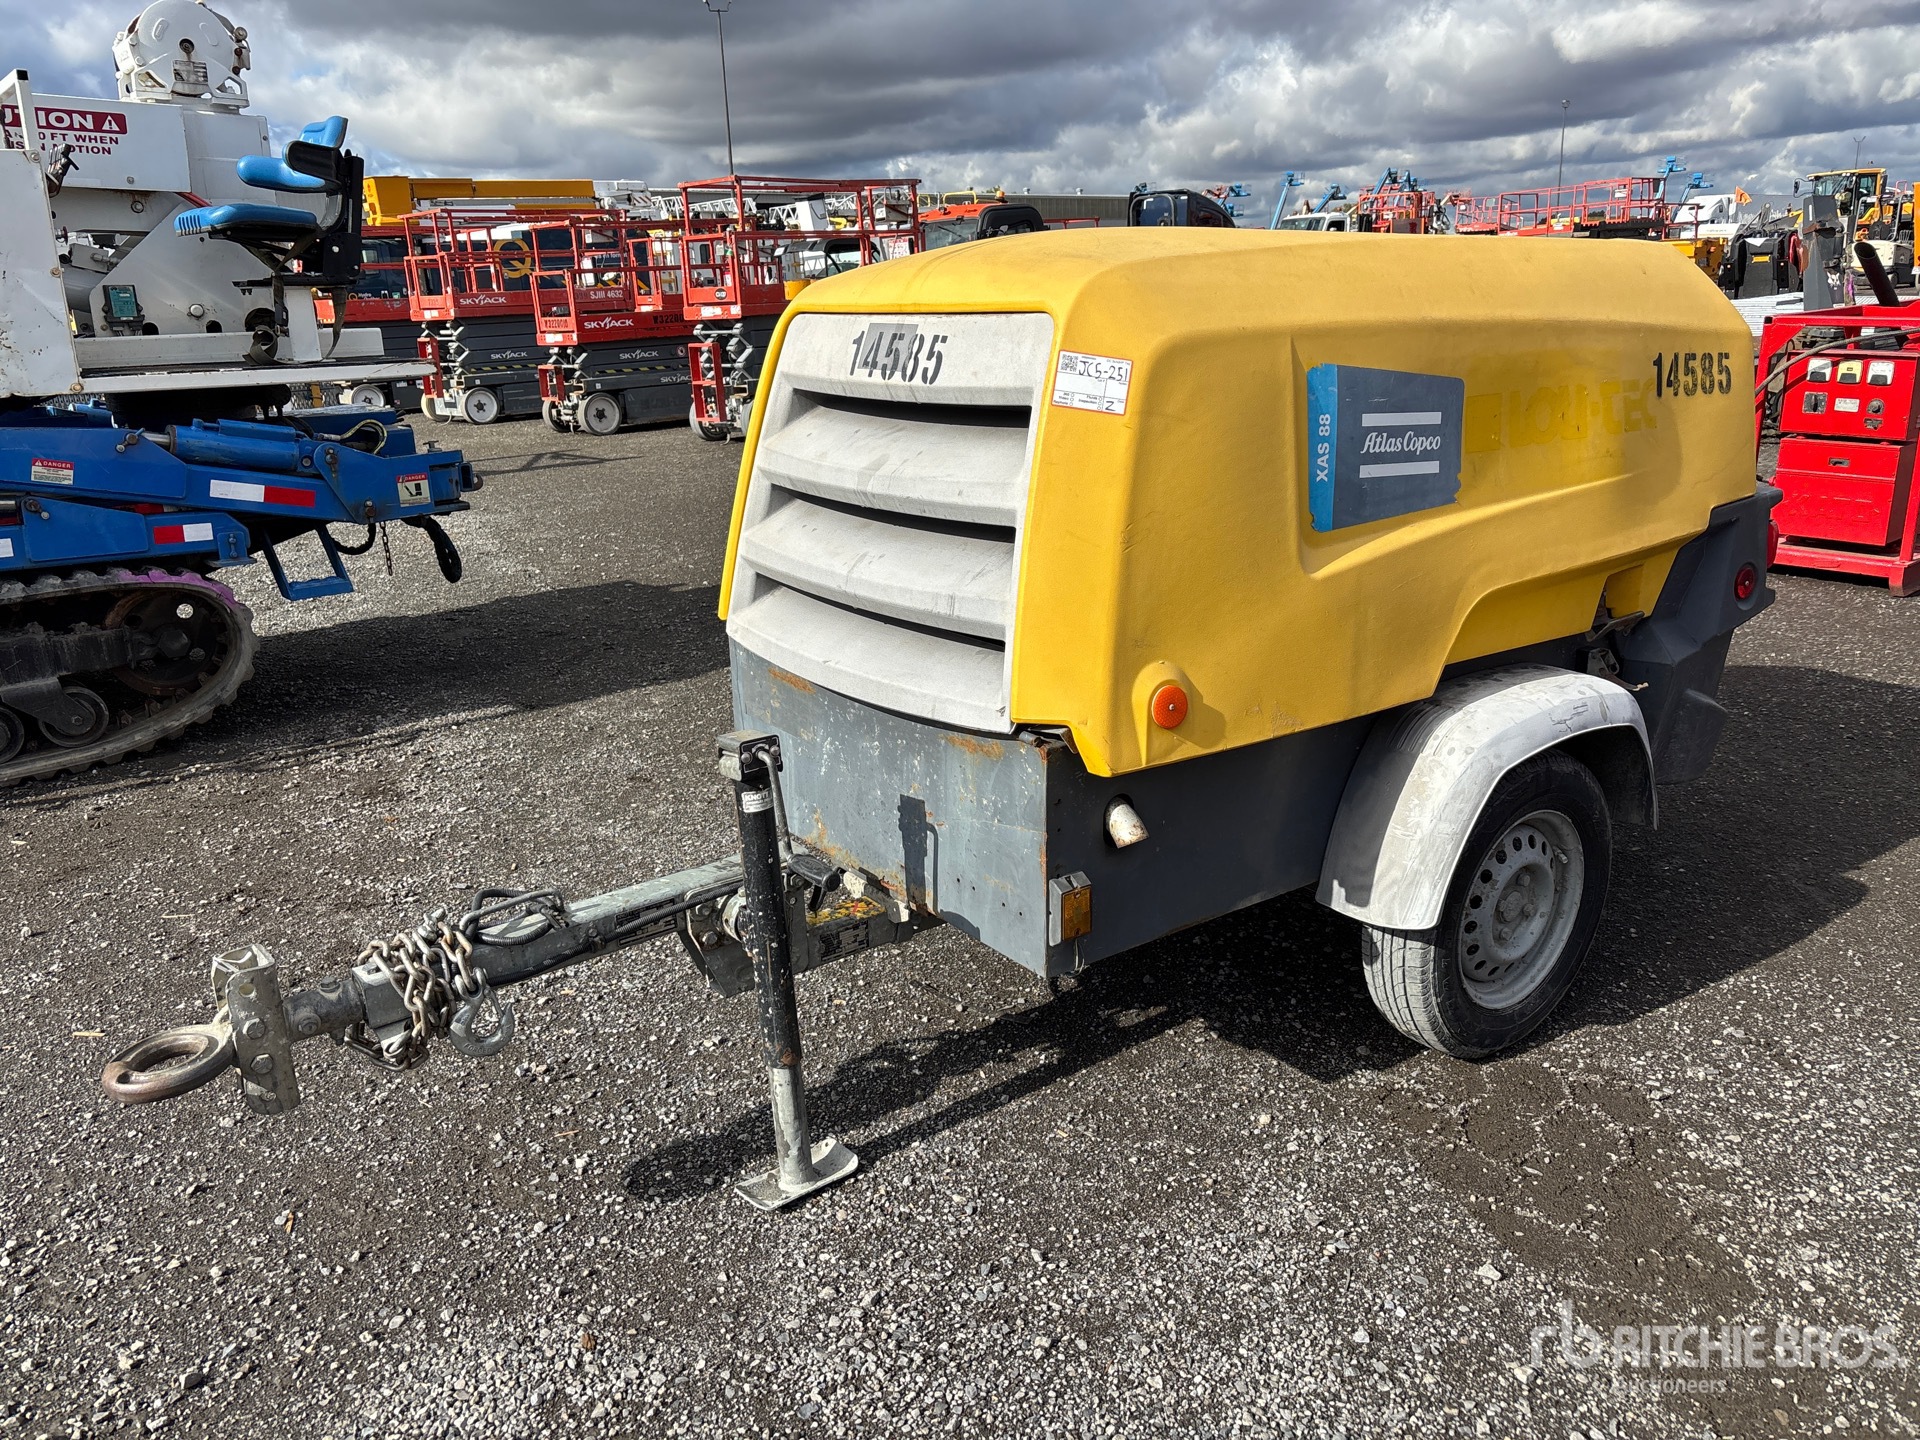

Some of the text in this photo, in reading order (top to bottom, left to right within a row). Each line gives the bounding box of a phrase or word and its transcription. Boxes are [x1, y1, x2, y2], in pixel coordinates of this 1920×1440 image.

[50, 132, 68, 141] FT
[74, 134, 119, 145] WHEN
[459, 294, 507, 306] SKYJACK
[607, 289, 623, 299] 4632
[583, 316, 634, 330] SKYJACK
[490, 350, 528, 360] SKYJACK
[619, 349, 659, 359] SKYJACK
[849, 330, 949, 386] 14585
[660, 372, 692, 383] SKYJAC
[1652, 351, 1732, 398] 14585
[1316, 413, 1331, 482] XAS 88
[1360, 431, 1441, 455] Atlas Copco
[43, 460, 71, 468] DANGER
